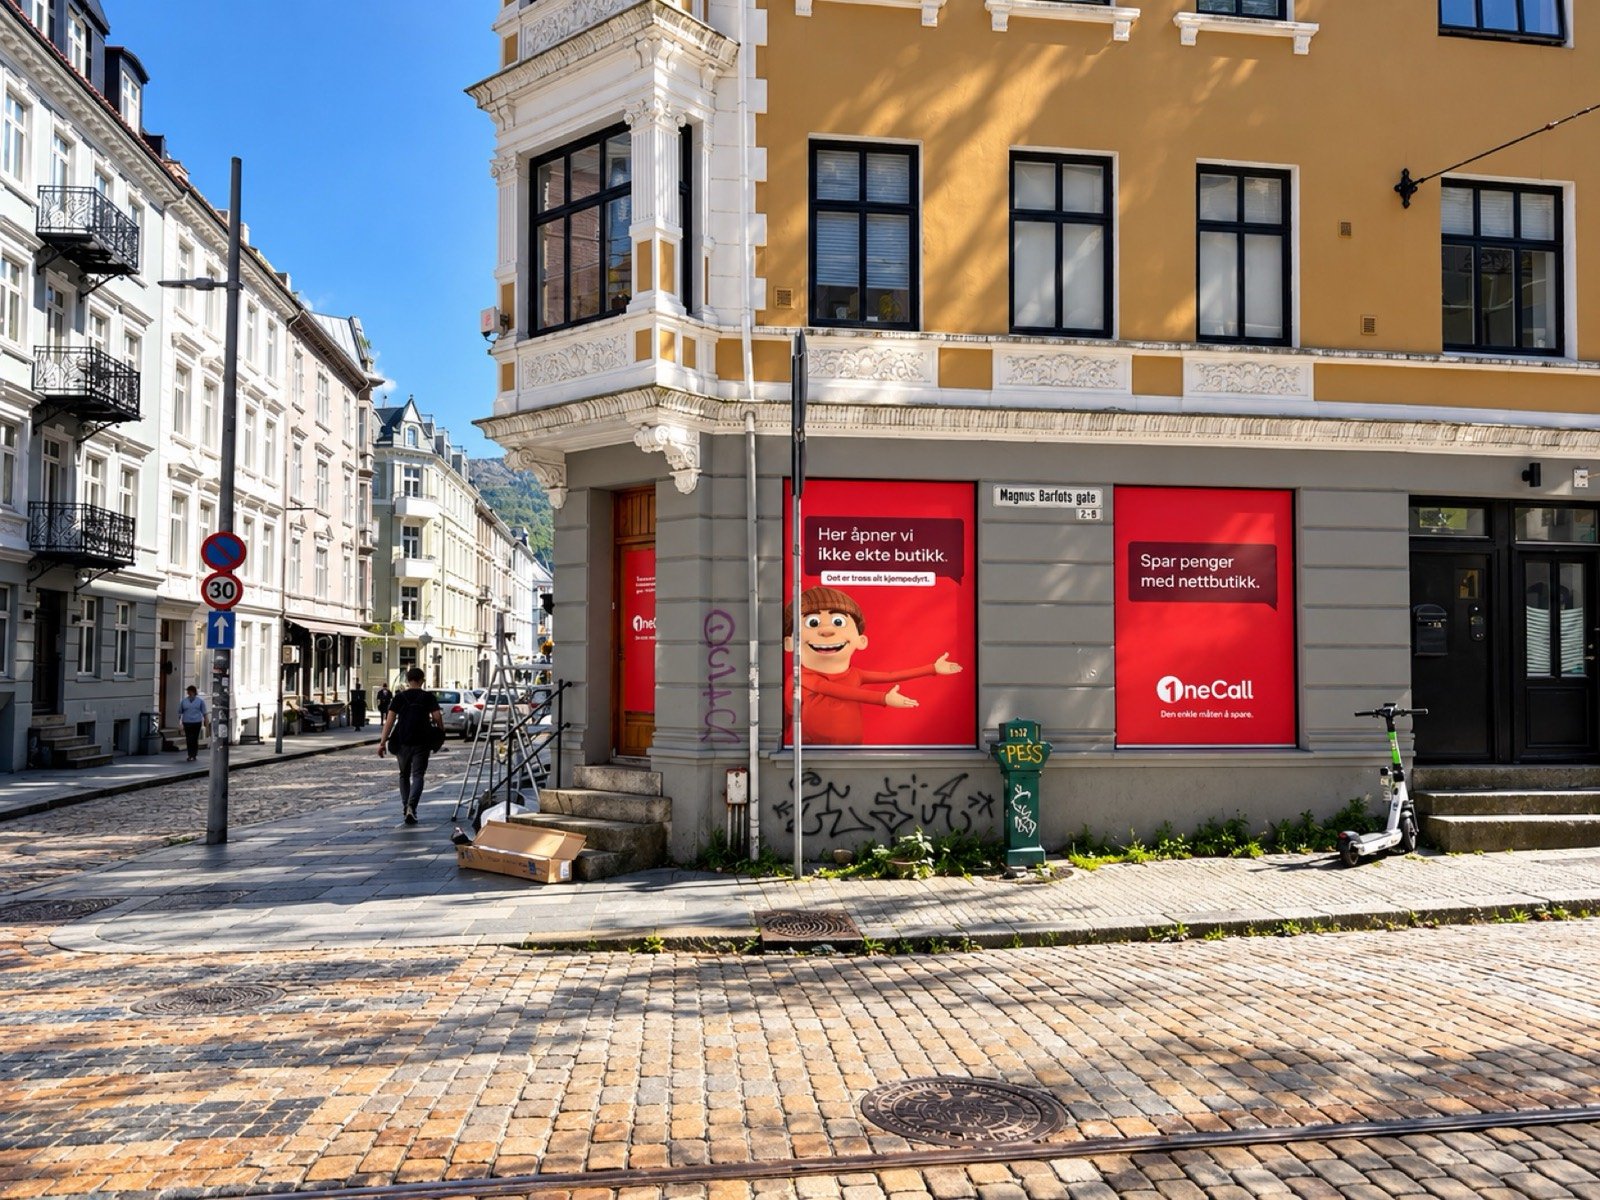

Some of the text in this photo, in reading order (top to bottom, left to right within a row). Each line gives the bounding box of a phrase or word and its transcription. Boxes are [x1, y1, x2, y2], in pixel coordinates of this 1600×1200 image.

[1000, 489, 1096, 505] Magnus Barfots gate
[818, 526, 914, 544] Her åpner vi
[818, 547, 948, 563] ikke ekte butikk.
[1140, 553, 1234, 571] Spar penger
[826, 574, 841, 582] Det
[851, 574, 872, 582] tross
[873, 574, 883, 582] alt
[884, 574, 930, 584] kjempedyrt.
[1140, 574, 1260, 589] med nettbutikk.
[209, 581, 235, 600] 30
[1160, 709, 1254, 719] Den enkle måten å spare.
